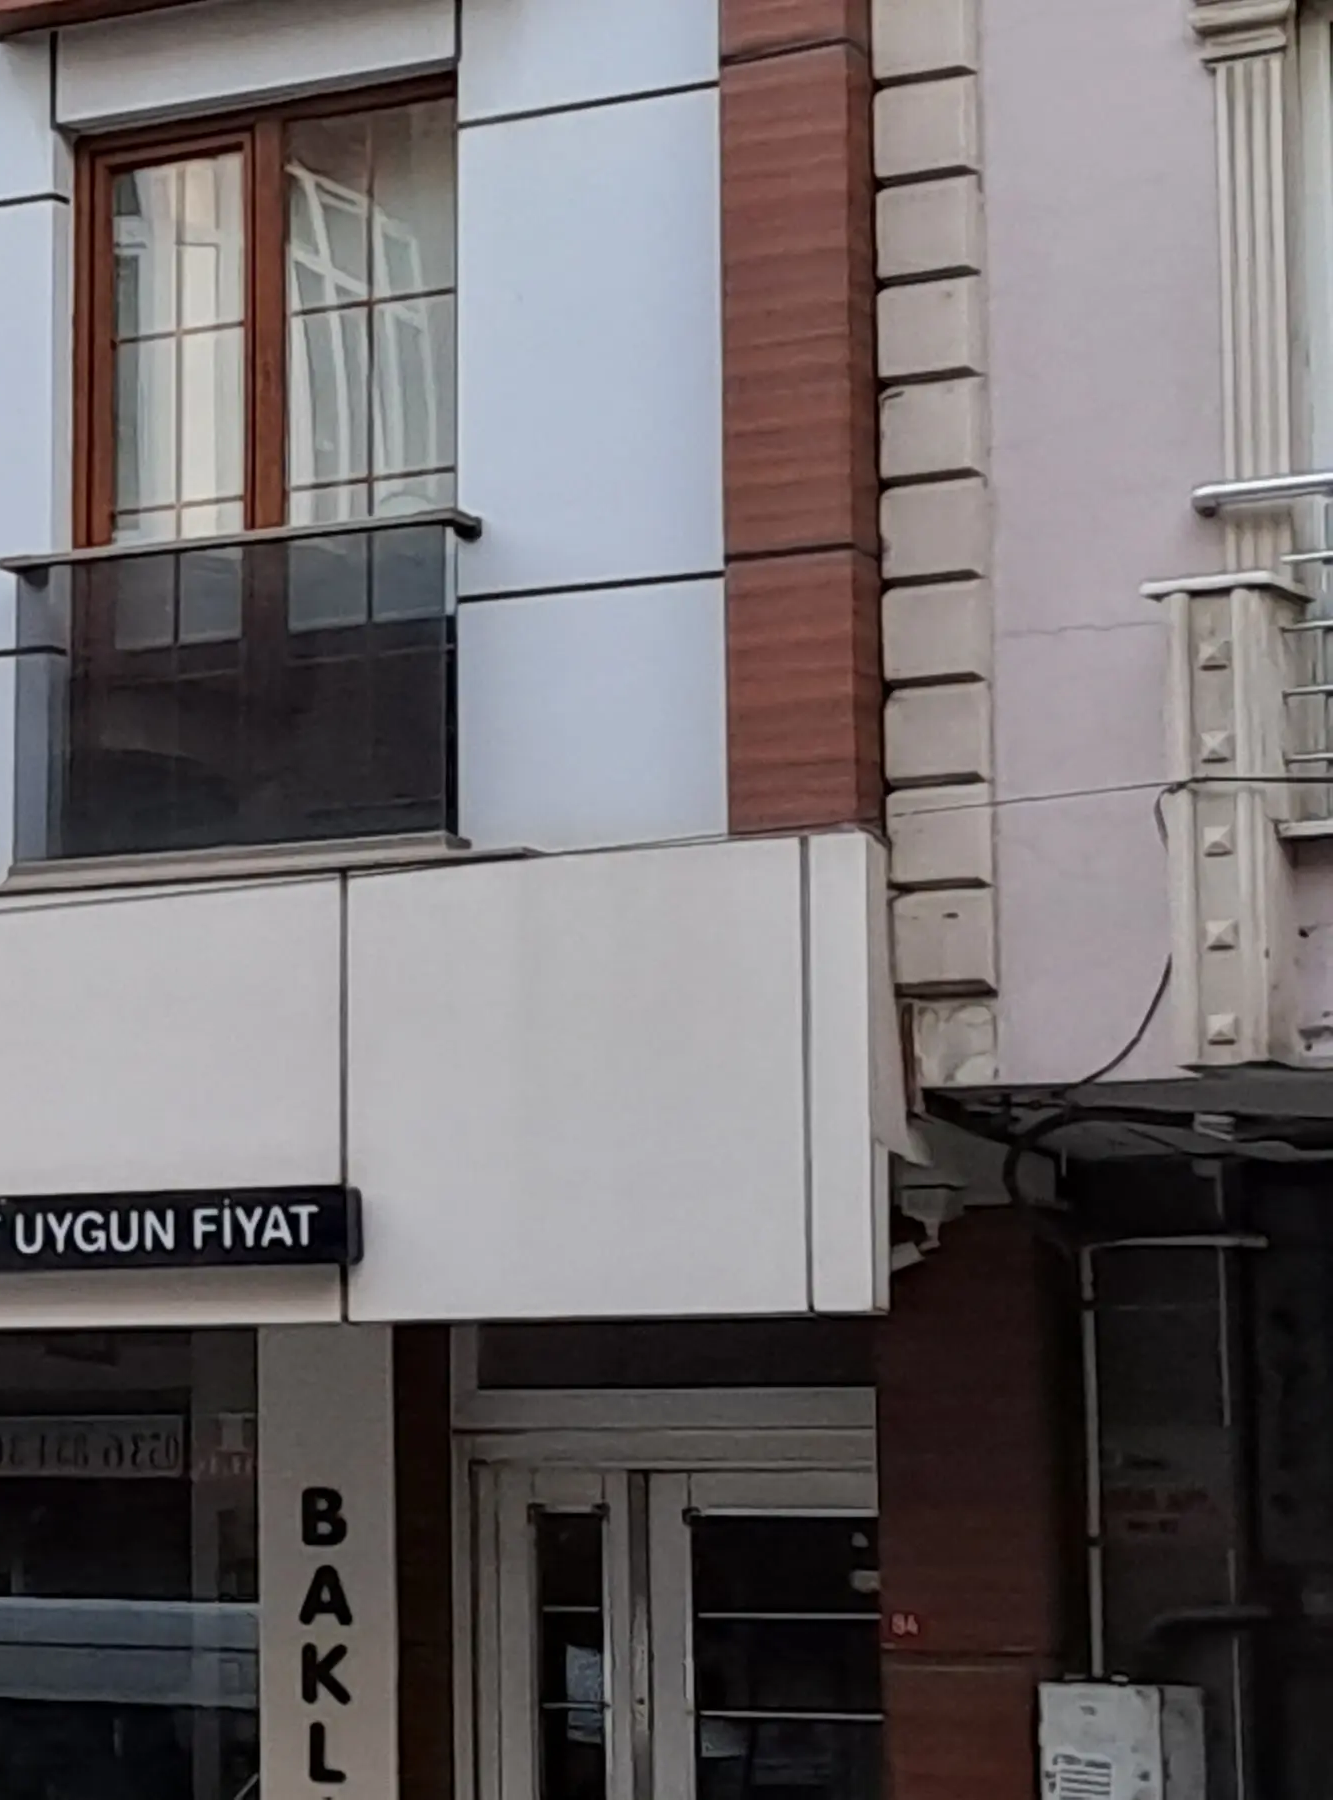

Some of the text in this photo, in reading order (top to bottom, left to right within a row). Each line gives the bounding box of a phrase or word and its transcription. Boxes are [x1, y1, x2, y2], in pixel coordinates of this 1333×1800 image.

[15, 1208, 175, 1254] UYGUN
[193, 1198, 319, 1250] FİYAT
[299, 1486, 353, 1800] BAKL
